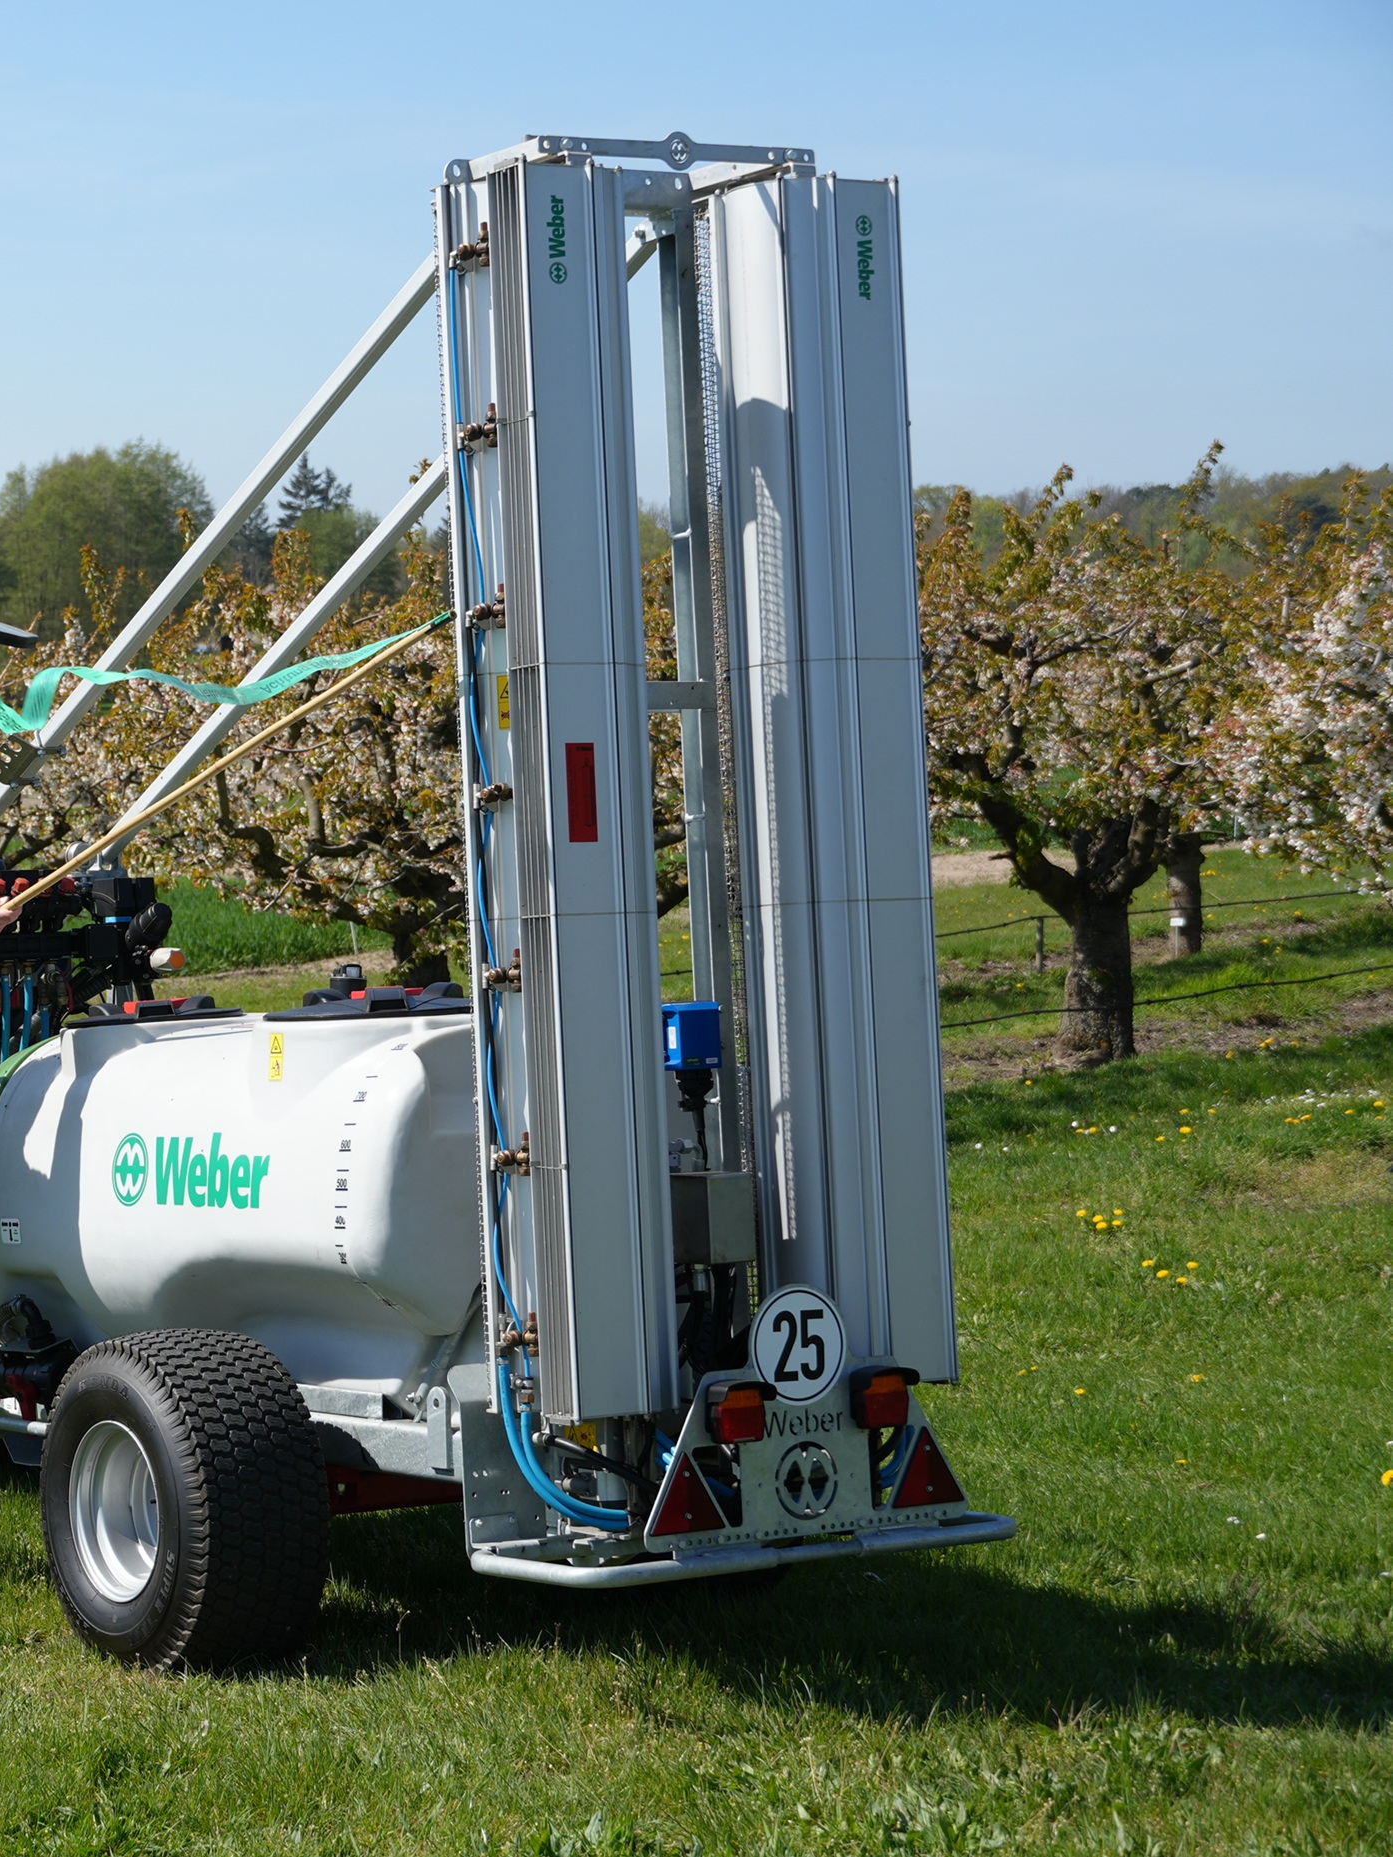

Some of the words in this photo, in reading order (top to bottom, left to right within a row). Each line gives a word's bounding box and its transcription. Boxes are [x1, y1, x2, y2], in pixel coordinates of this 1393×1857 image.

[546, 194, 566, 259] Weber
[856, 239, 875, 301] Weber
[156, 1132, 271, 1210] Weber
[340, 1139, 352, 1149] 600
[336, 1178, 348, 1188] 500
[773, 1309, 825, 1383] 25
[764, 1407, 844, 1438] Weber
